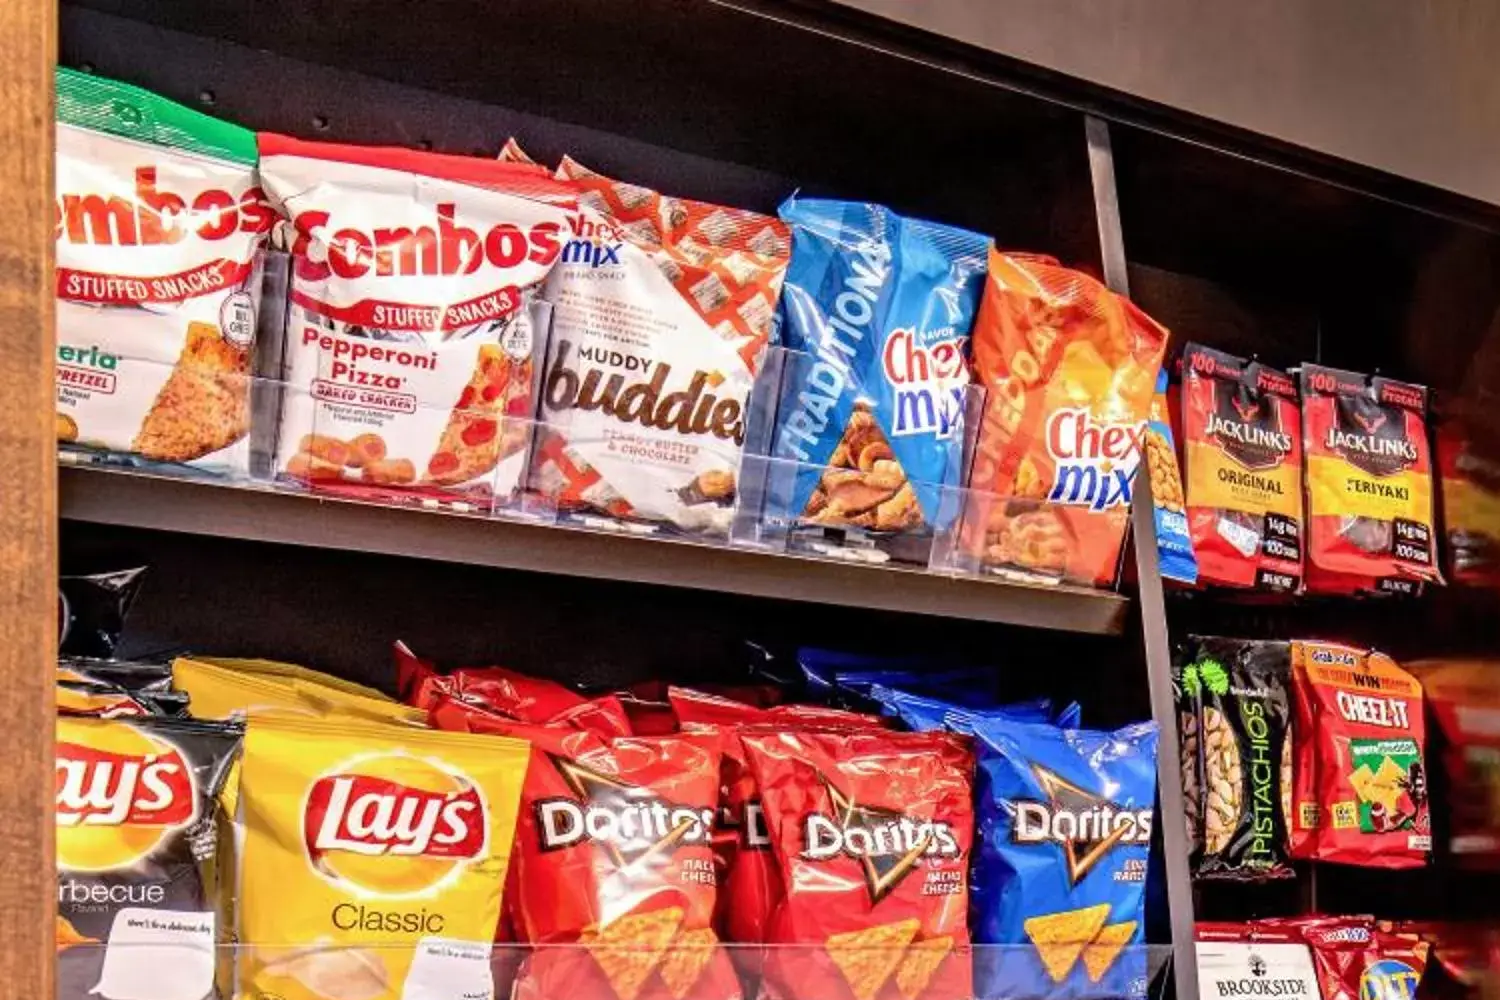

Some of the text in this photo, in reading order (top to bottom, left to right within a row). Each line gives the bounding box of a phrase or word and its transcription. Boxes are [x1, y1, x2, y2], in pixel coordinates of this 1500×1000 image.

[56, 167, 274, 246] mbos
[293, 204, 563, 282] Combos
[561, 238, 623, 268] mix
[67, 267, 226, 299] STUFFED SNACKS
[447, 291, 512, 325] SNACKS
[302, 327, 437, 370] Pepperoni
[578, 346, 653, 373] MUDDY
[331, 362, 401, 389] Pizza
[1049, 411, 1149, 463] Chex
[1205, 411, 1244, 445] JACK
[1326, 428, 1368, 454] JACK
[1051, 463, 1141, 510] mix
[1217, 467, 1285, 496] ORIGINAL
[1353, 672, 1381, 689] WIN
[57, 754, 177, 826] ay's
[1244, 702, 1273, 854] PISTACHIOS
[315, 778, 477, 856] Lay's
[1017, 801, 1154, 843] Doritos
[806, 814, 958, 859] Doritos
[332, 903, 444, 935] Classic
